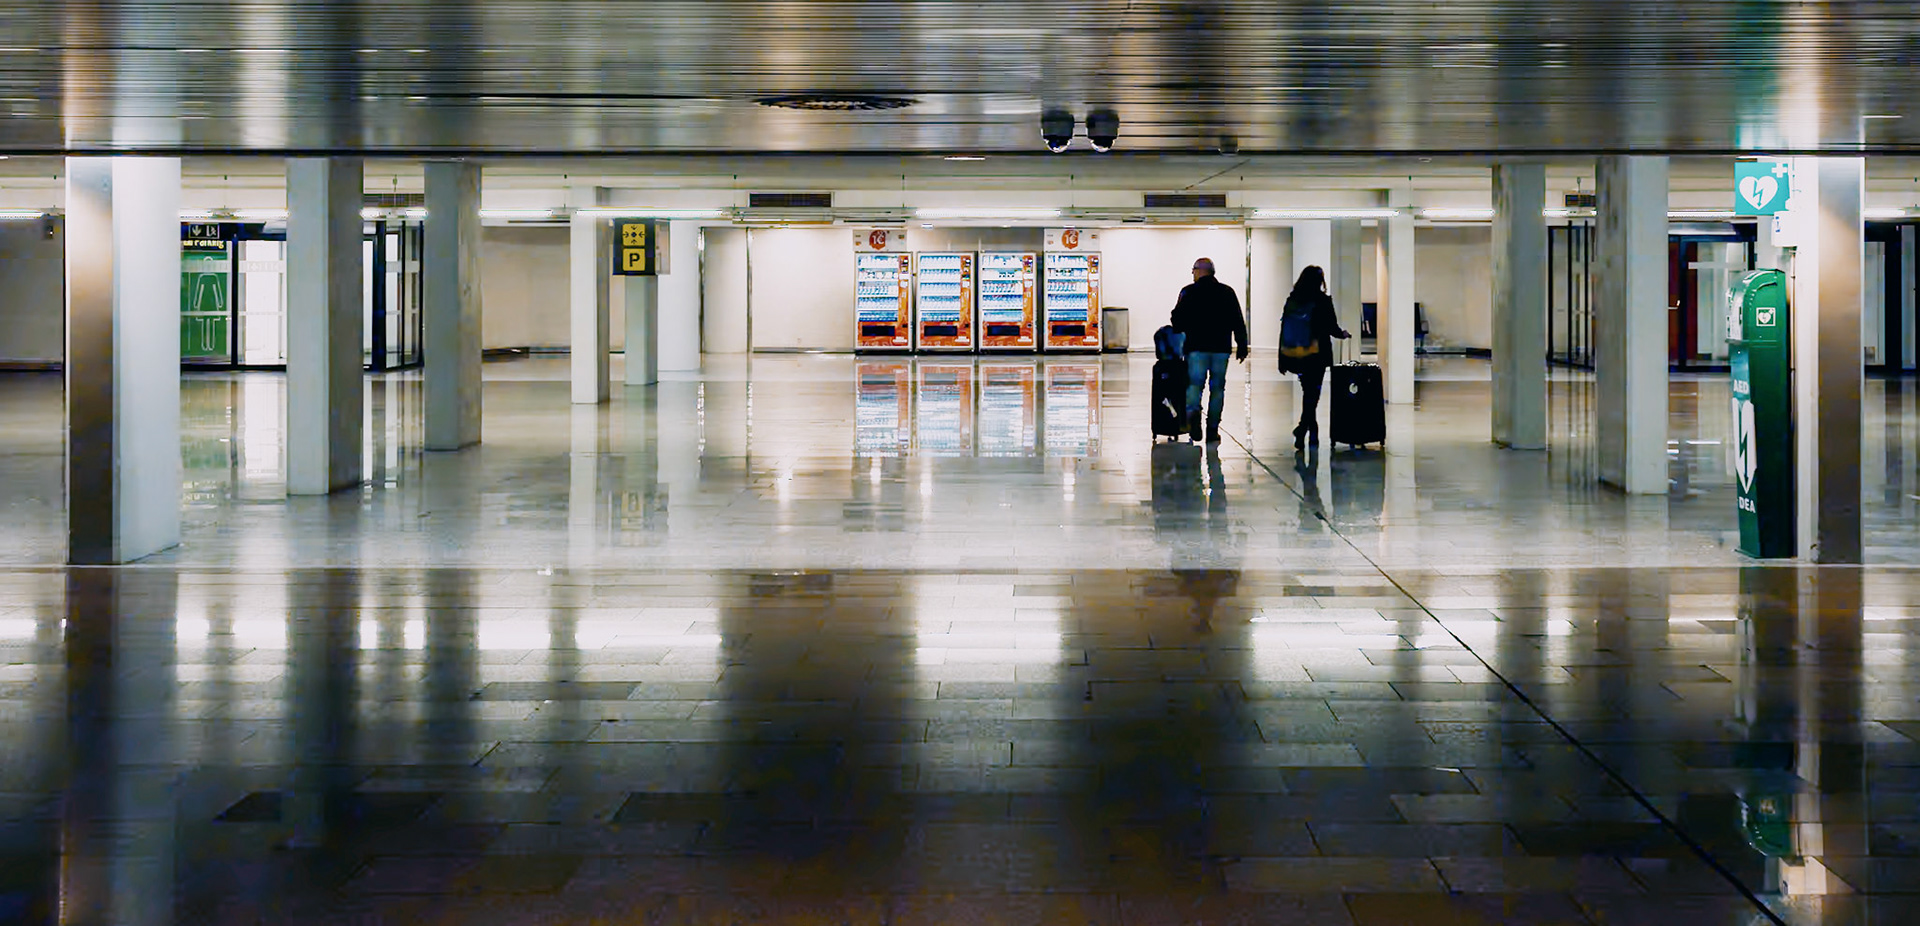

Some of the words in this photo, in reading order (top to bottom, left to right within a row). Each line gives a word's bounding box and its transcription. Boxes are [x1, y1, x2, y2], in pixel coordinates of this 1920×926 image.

[629, 253, 640, 267] P
[1733, 379, 1750, 394] AED
[1739, 496, 1756, 513] DEA
